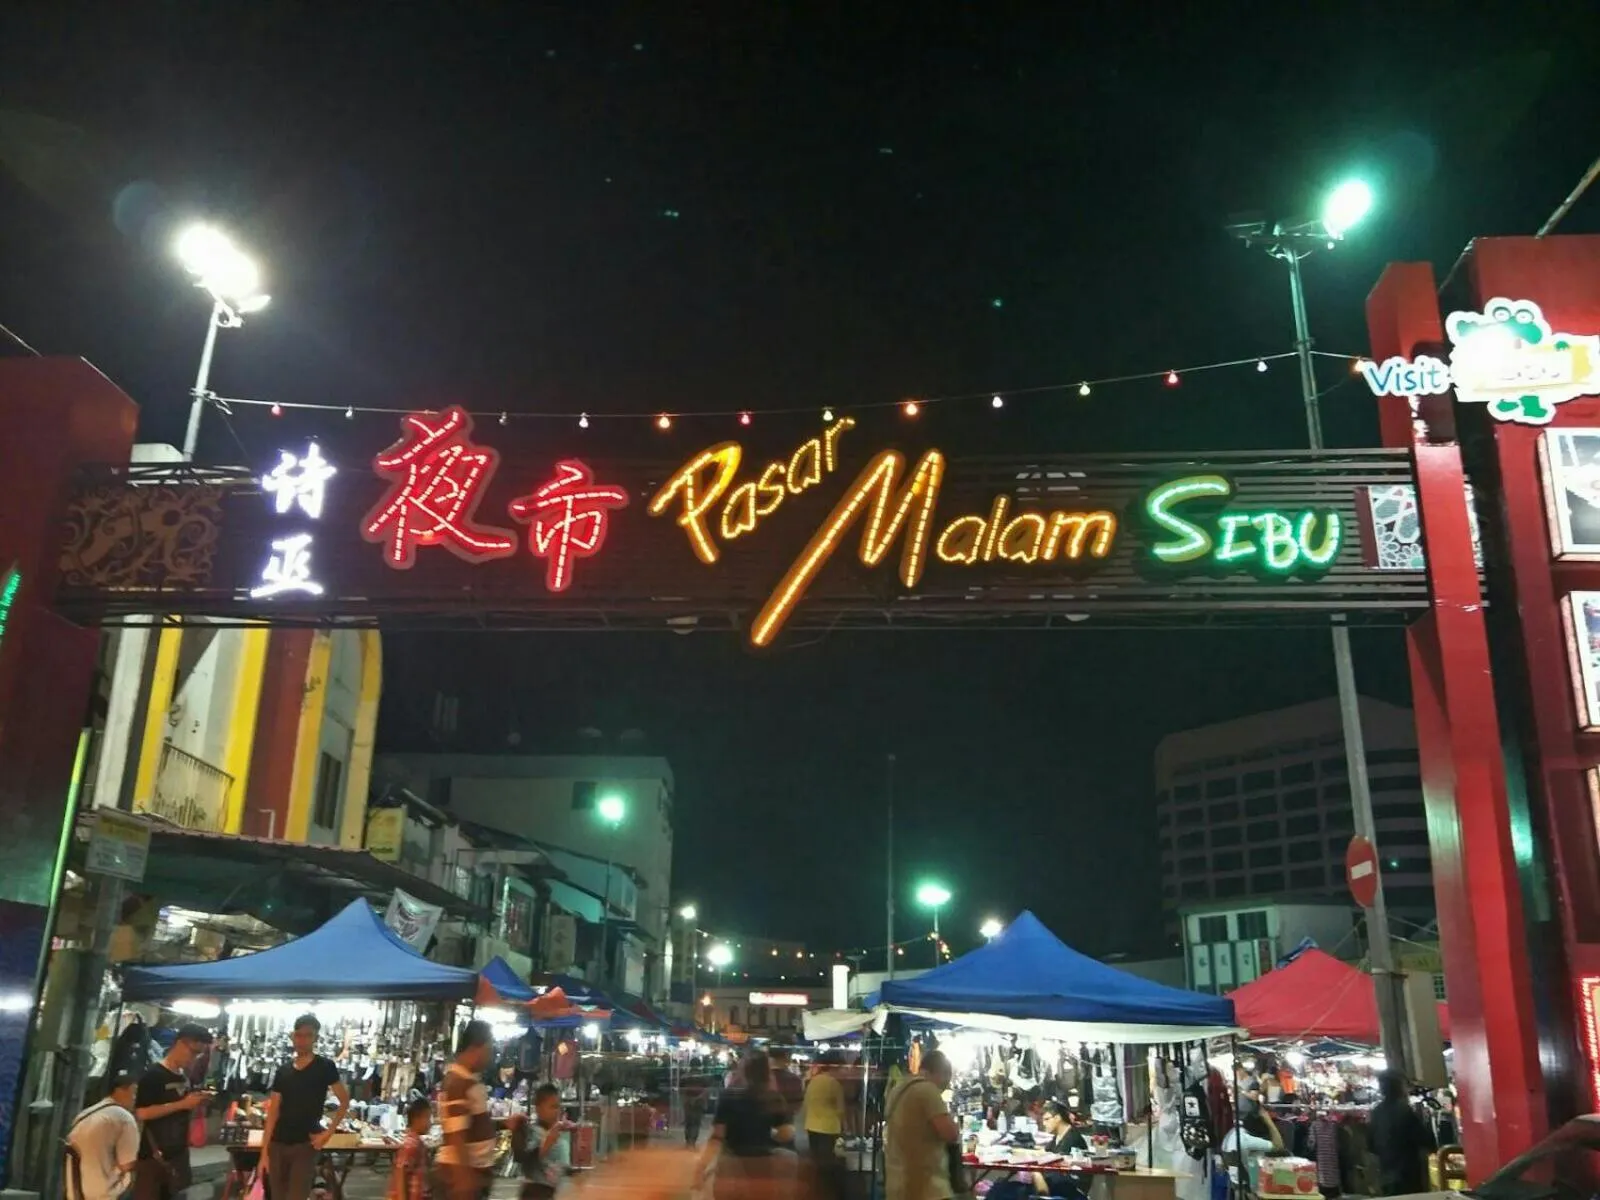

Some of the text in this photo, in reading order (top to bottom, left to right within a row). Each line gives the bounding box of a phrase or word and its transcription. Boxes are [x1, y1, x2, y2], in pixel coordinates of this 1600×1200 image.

[1369, 361, 1441, 391] Visit
[362, 407, 627, 591] 夜市
[649, 417, 1341, 645] Pasar Malam SIBU
